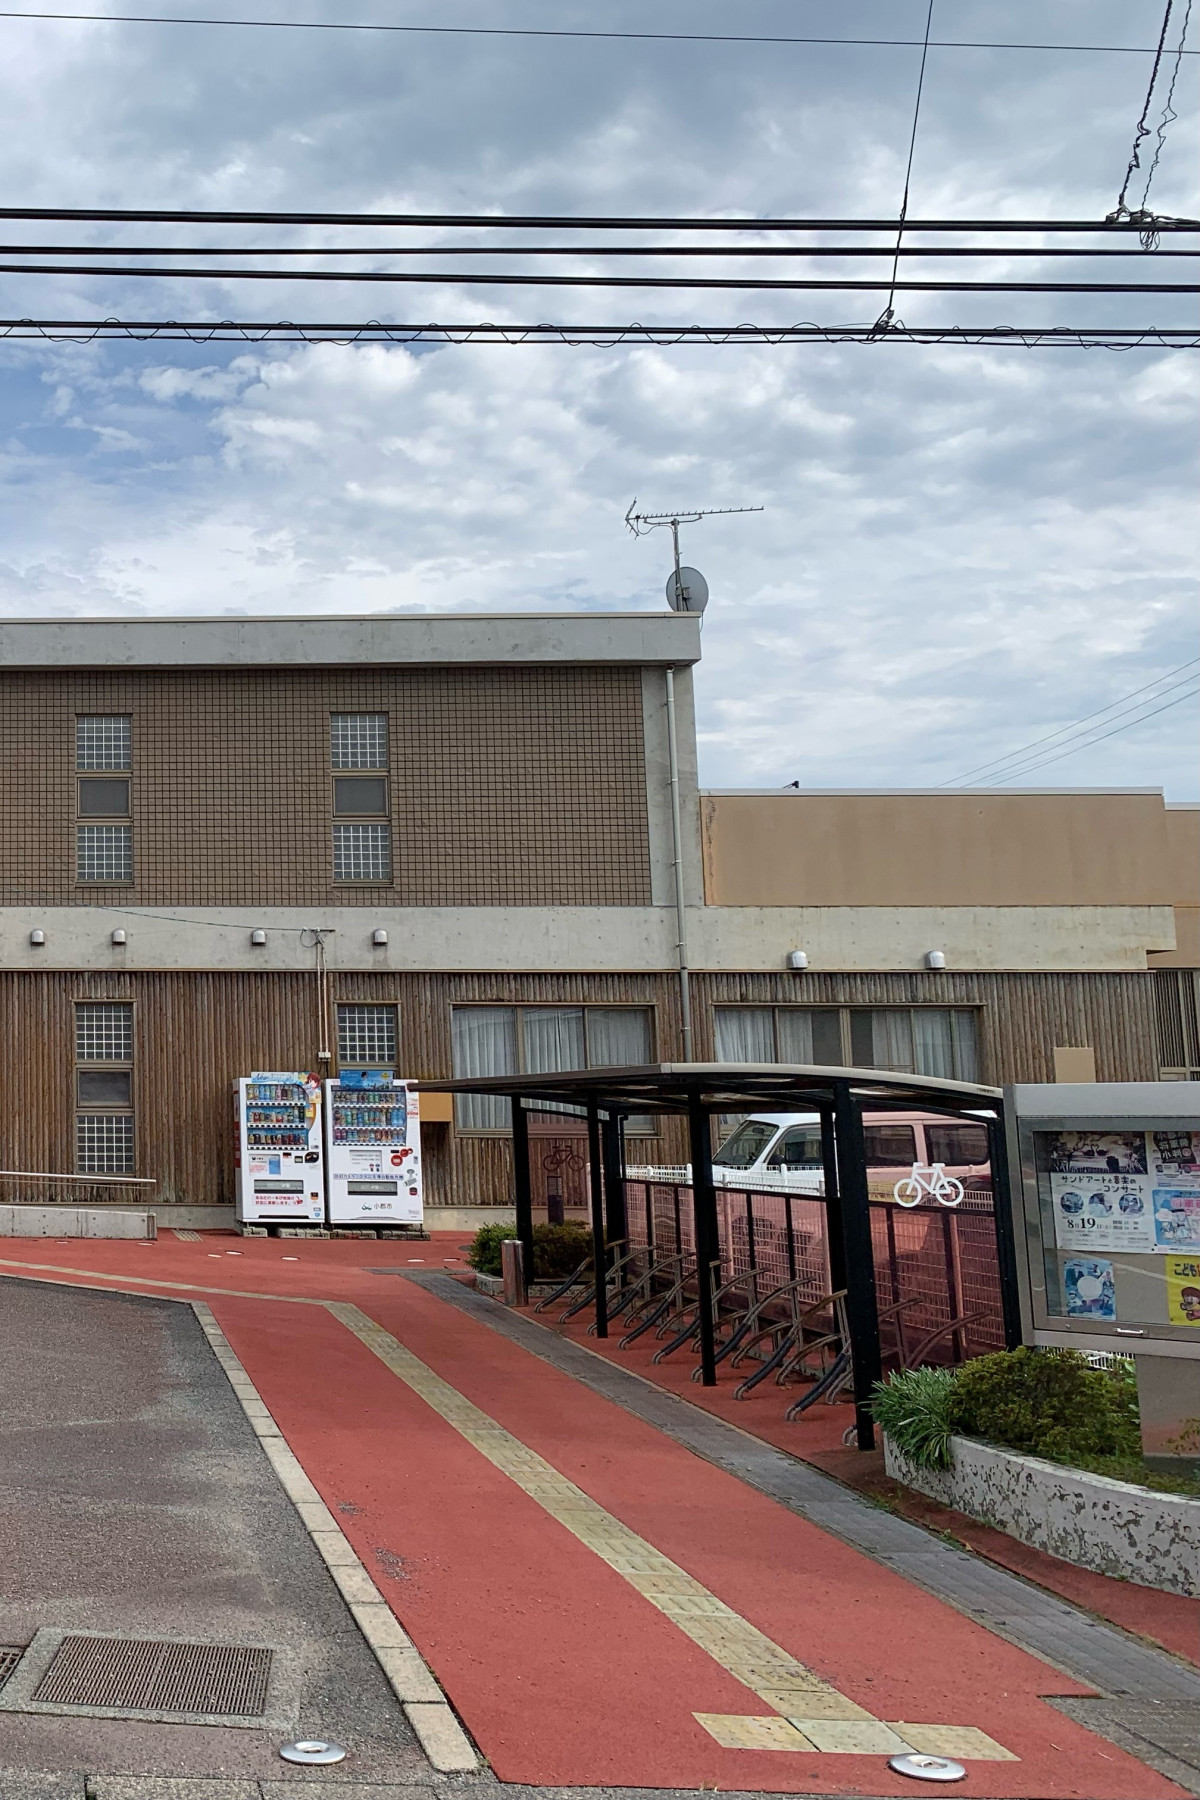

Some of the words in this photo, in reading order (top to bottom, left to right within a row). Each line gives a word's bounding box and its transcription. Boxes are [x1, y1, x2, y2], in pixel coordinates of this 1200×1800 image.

[1061, 1175, 1137, 1185] サンドアートと音楽の
[1103, 1185, 1144, 1194] コンサート
[373, 1202, 393, 1210] 小郡市
